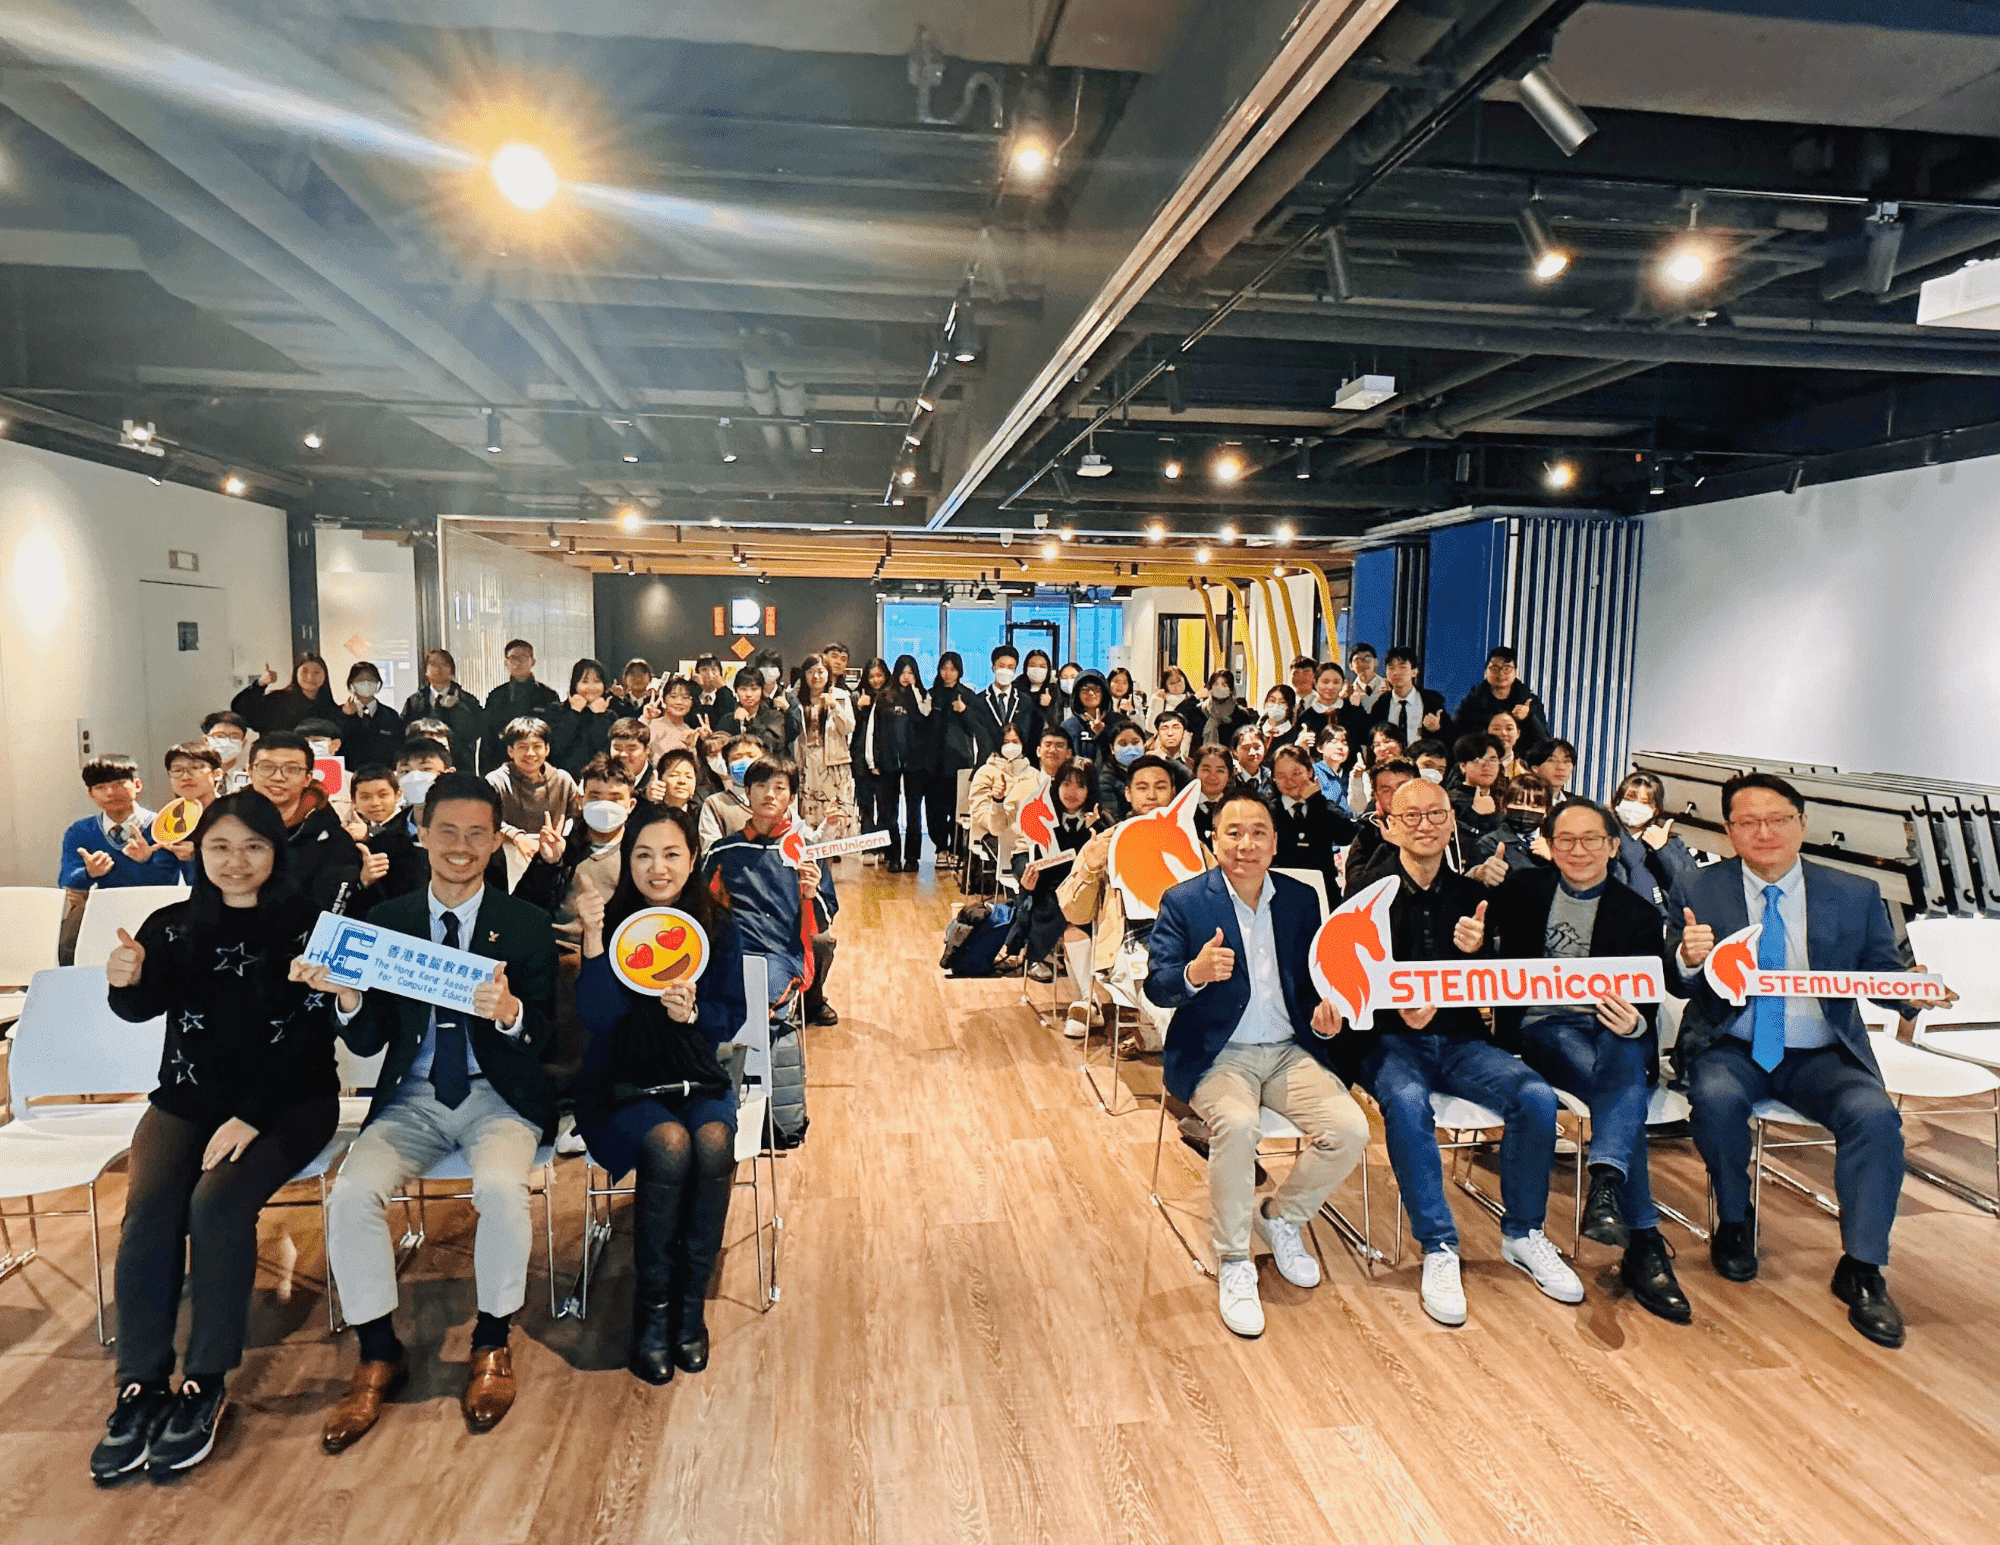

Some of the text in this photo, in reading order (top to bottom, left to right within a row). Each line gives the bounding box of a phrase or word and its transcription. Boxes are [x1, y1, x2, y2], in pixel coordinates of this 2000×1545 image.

[805, 836, 887, 859] STEMUnicorn
[375, 957, 390, 970] The
[393, 963, 415, 979] Hong
[418, 970, 440, 985] Kong
[377, 970, 393, 982] for
[397, 976, 438, 994] Computer
[1388, 964, 1656, 1003] STEMUnicorn
[1758, 975, 1941, 997] STEMUnicorn
